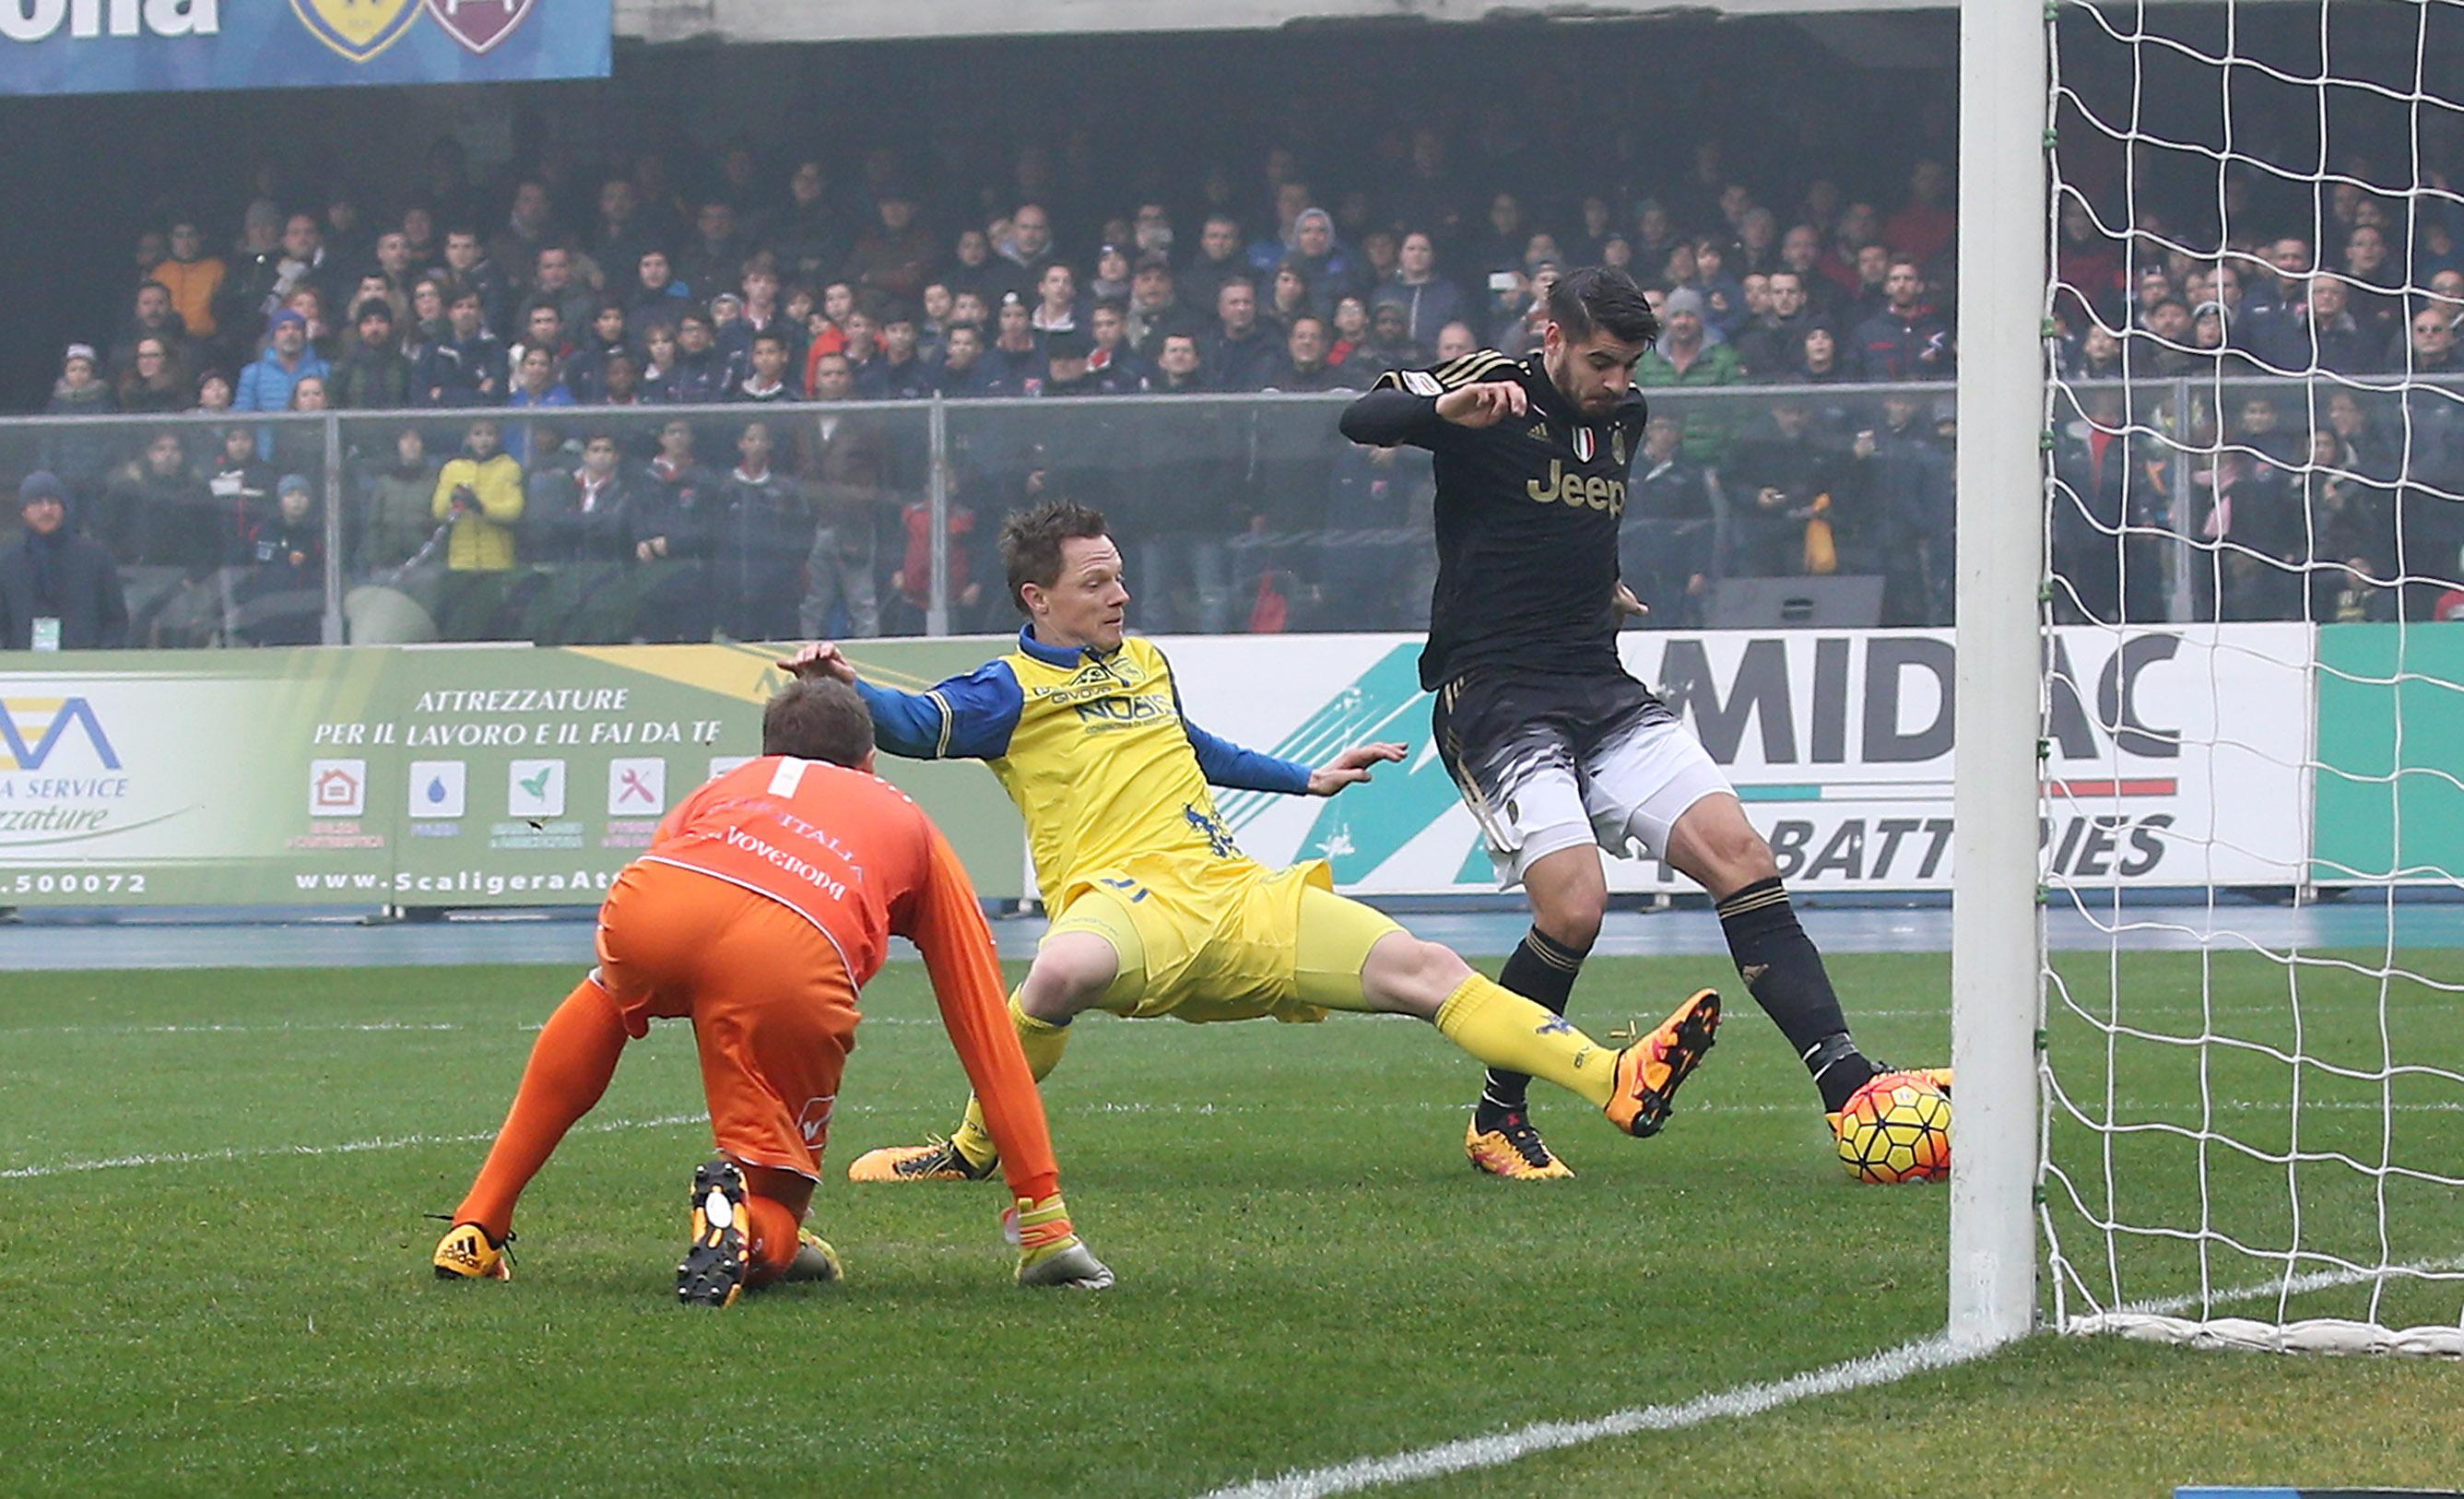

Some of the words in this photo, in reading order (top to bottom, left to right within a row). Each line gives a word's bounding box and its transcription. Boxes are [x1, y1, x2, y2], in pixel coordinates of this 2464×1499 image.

[1527, 458, 1625, 521] Jeep
[415, 688, 629, 713] ATTREZZATURE
[313, 722, 365, 745] PER
[371, 722, 396, 744] IL
[406, 724, 526, 746] LAVORO
[534, 724, 550, 745] E
[557, 724, 580, 745] IL
[590, 722, 633, 744] FAI
[640, 721, 681, 743] DA
[691, 720, 723, 742] TE
[26, 778, 128, 798] SERVICE
[1769, 814, 2175, 879] BATTIES
